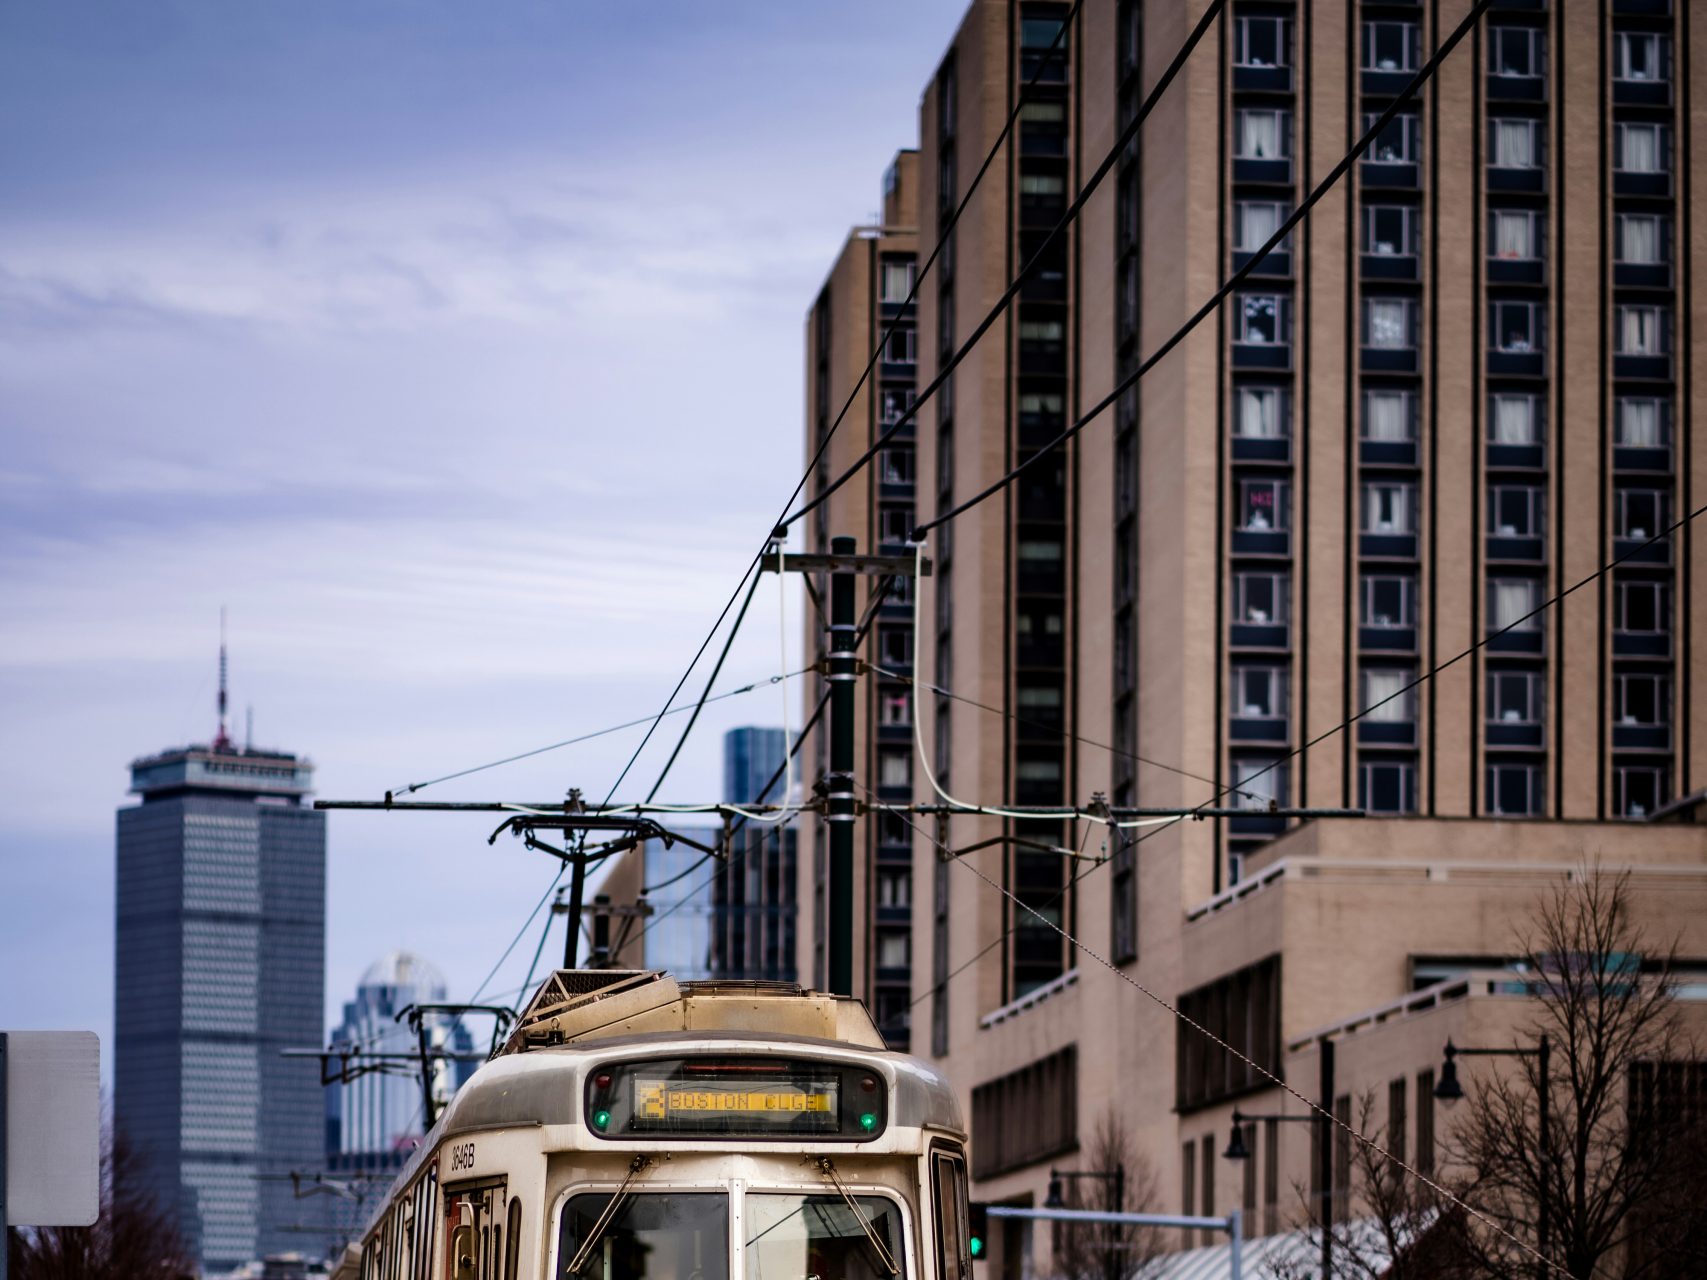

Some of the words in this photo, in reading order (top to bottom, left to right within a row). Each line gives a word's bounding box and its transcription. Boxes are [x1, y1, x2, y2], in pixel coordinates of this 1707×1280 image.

[670, 1093, 749, 1109] BOSTON
[765, 1093, 817, 1110] CLGE
[451, 1143, 475, 1171] 3646B
